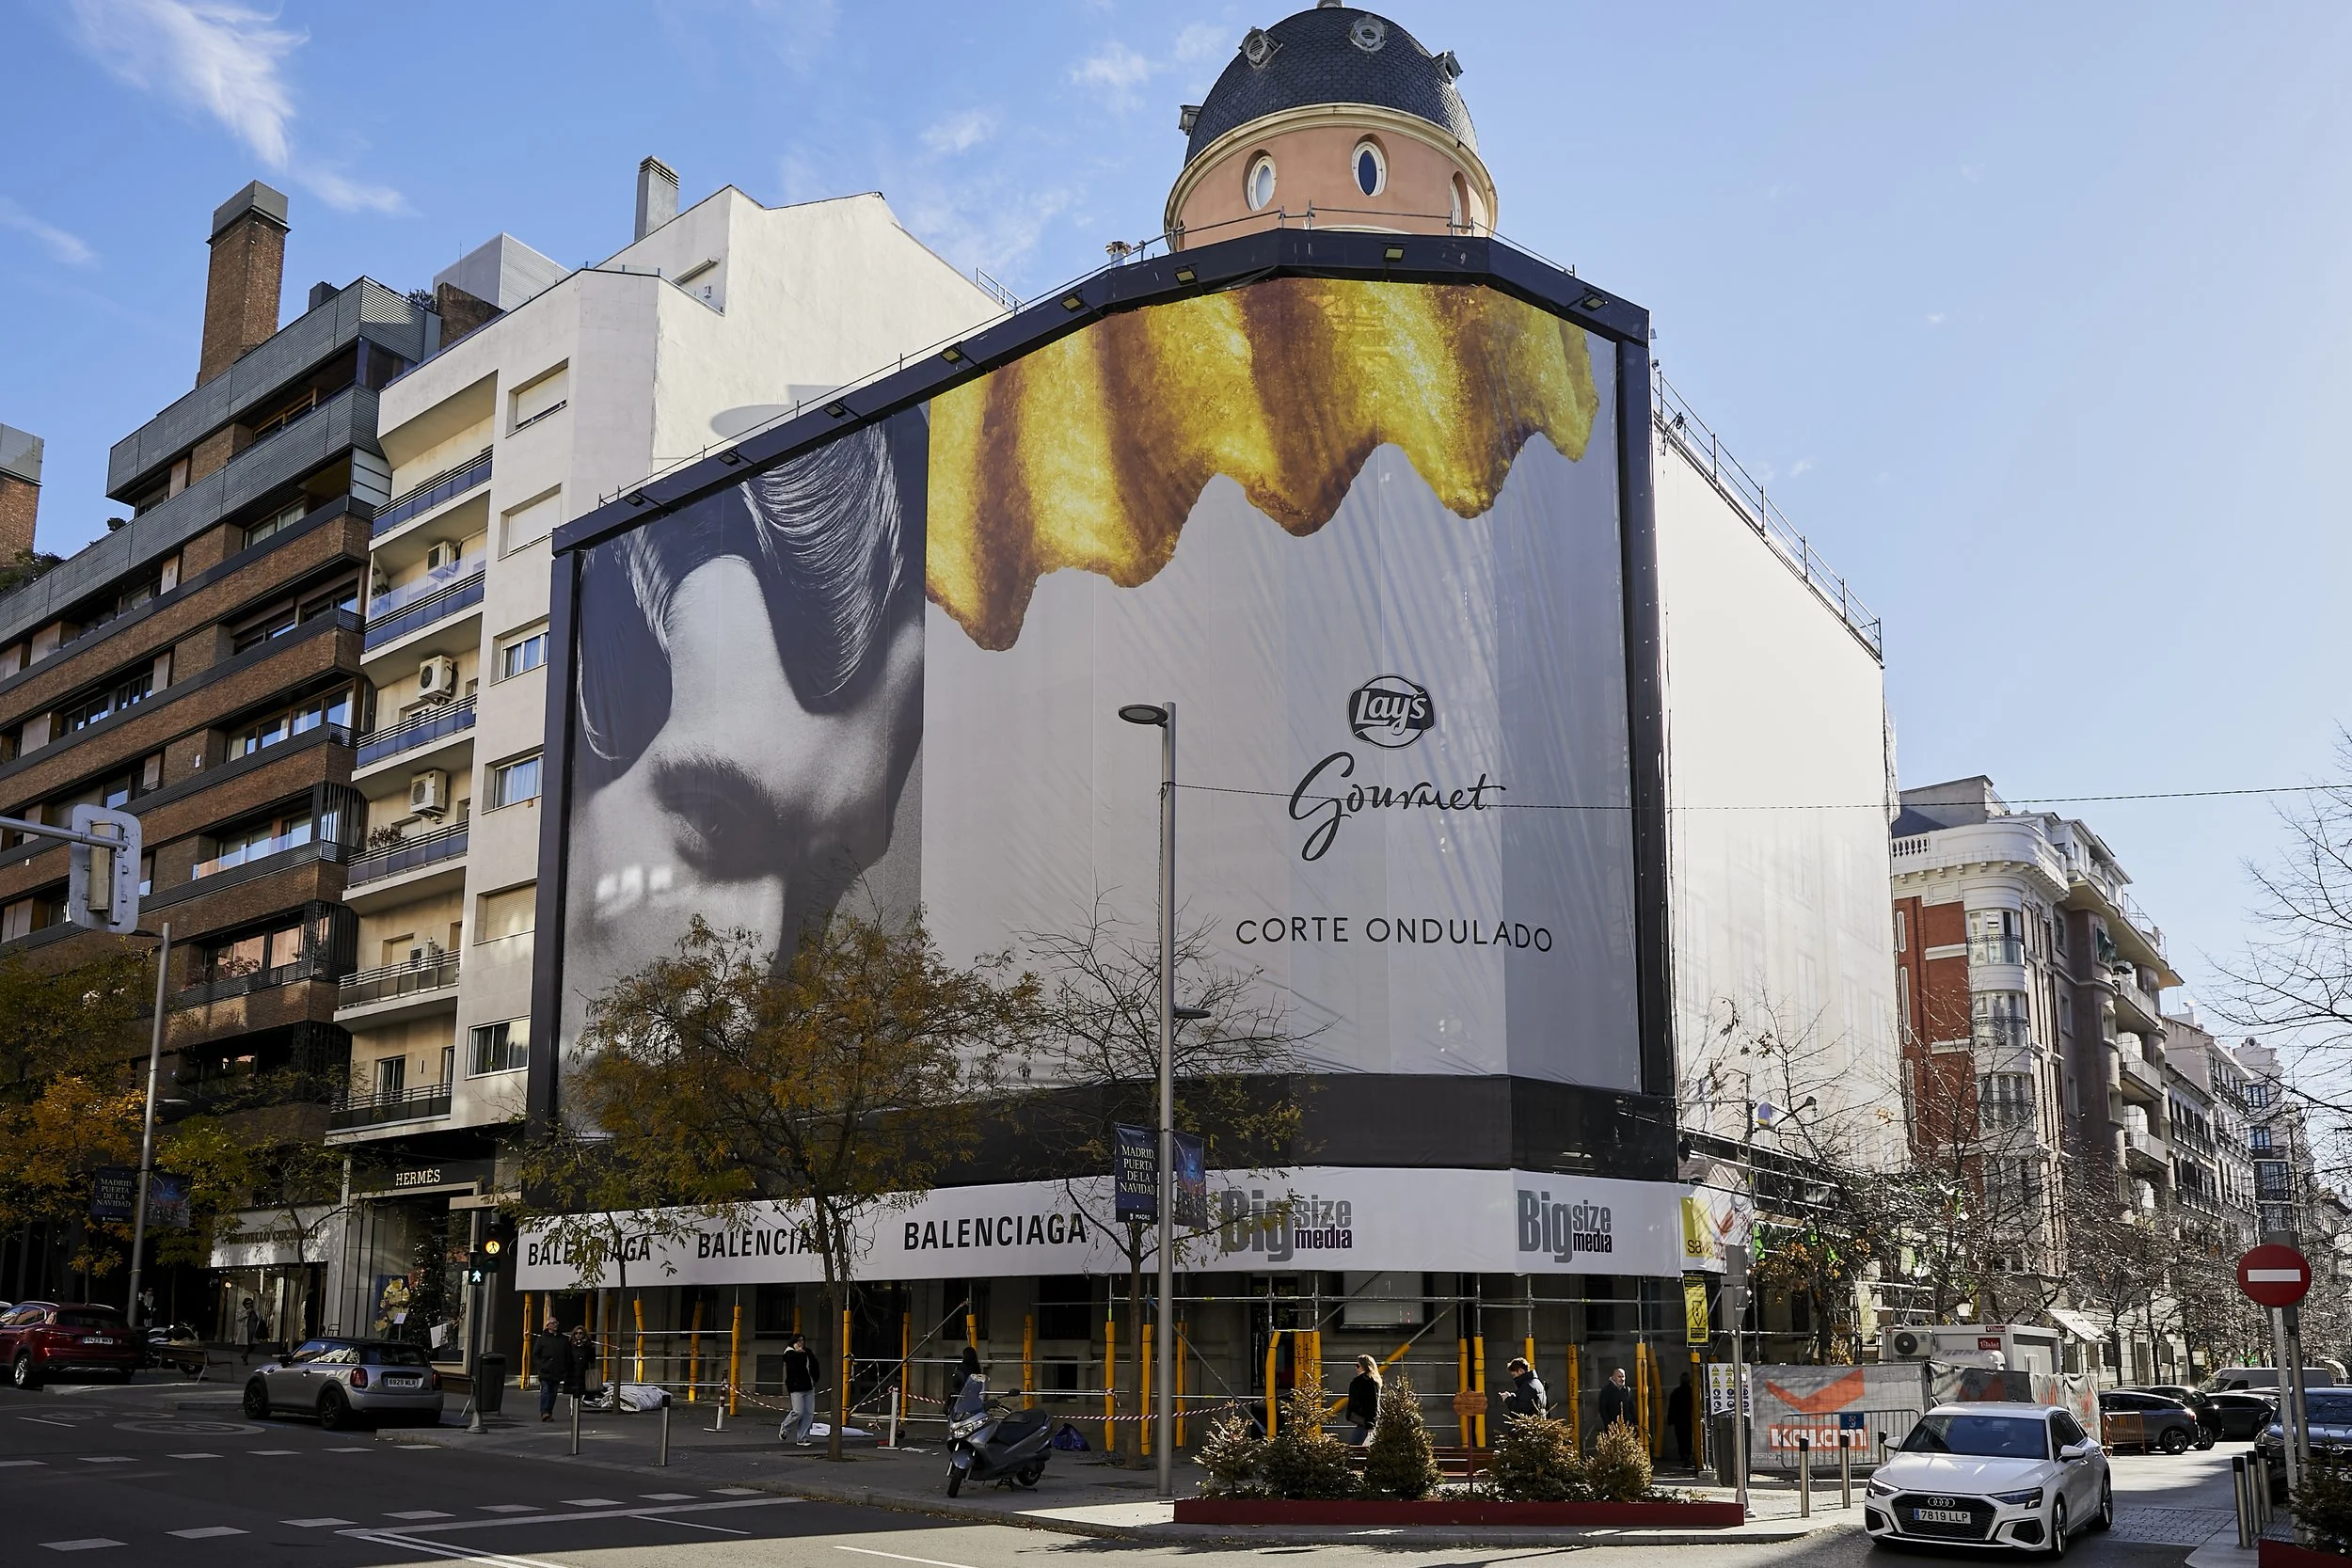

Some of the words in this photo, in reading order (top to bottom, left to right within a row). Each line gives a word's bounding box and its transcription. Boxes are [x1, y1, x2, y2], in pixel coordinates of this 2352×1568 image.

[1355, 690, 1427, 736] Lay's
[1288, 752, 1506, 862] Gourmet
[1235, 916, 1349, 944] CORTE
[1365, 917, 1552, 952] ONDULADO
[1123, 1158, 1153, 1171] PUERTA
[1127, 1170, 1138, 1180] DE
[1140, 1172, 1151, 1182] LA
[101, 1185, 130, 1194] PUERTA
[1120, 1182, 1155, 1196] NAVIDAD
[97, 1199, 132, 1208] NAVIDAD
[904, 1212, 1087, 1250] BALENCIAGA
[1221, 1190, 1295, 1262] Big
[1295, 1195, 1352, 1228] size
[1295, 1224, 1353, 1249] media
[1518, 1190, 1572, 1263] Big
[1572, 1199, 1612, 1233] size
[697, 1226, 848, 1259] BALENCIA
[1573, 1228, 1613, 1253] media
[1921, 1510, 1946, 1521] 7819
[1948, 1512, 1968, 1523] LLP
